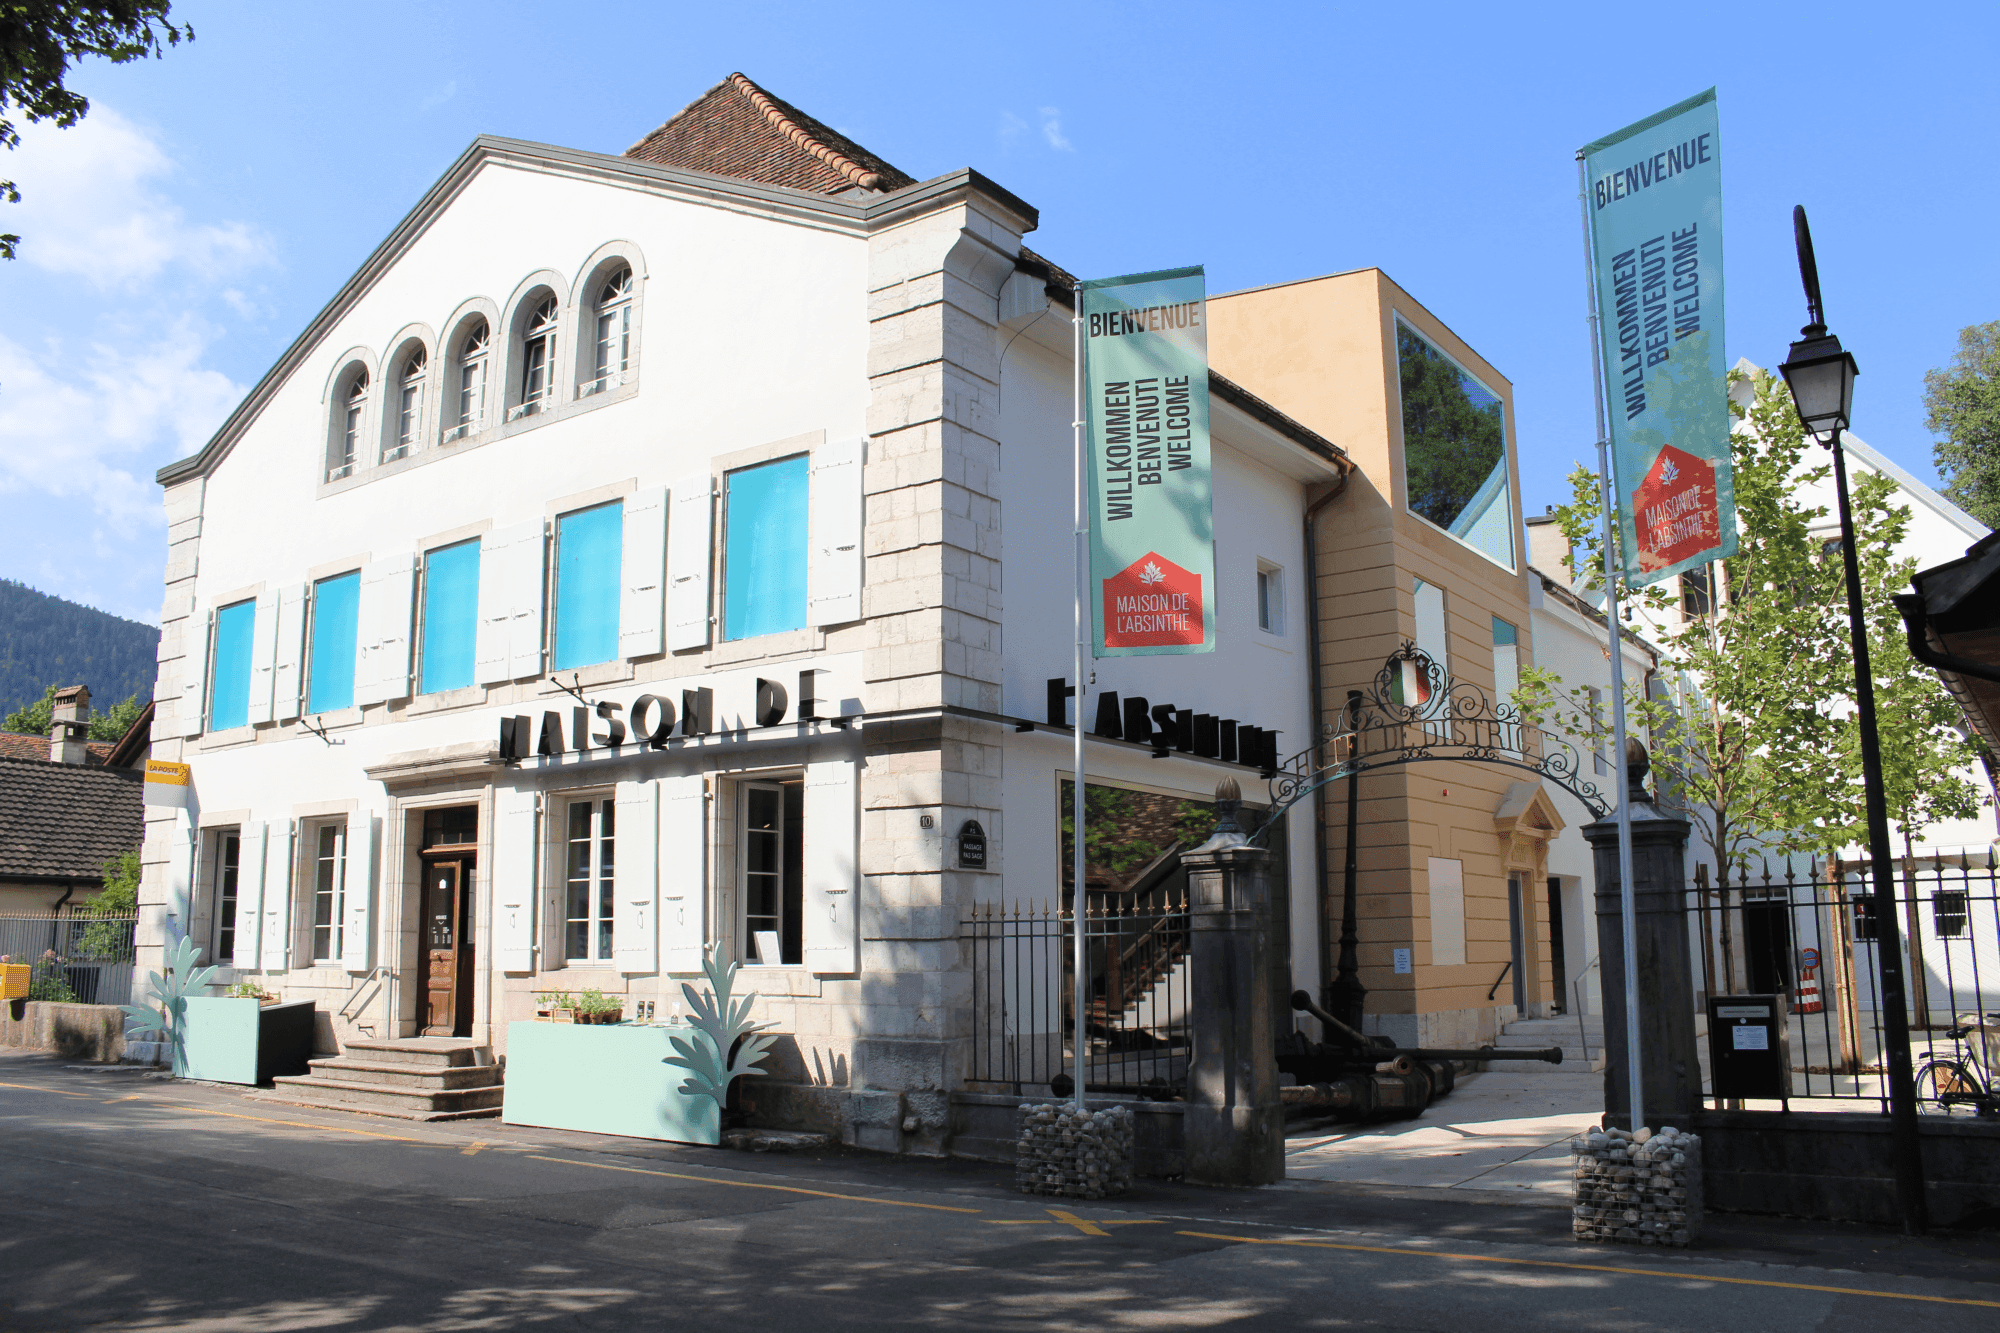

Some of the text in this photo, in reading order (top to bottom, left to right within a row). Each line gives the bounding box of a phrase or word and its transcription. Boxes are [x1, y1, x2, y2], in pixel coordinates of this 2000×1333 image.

[1595, 133, 1711, 210] BIENVENUE
[1090, 301, 1200, 338] BIENVENUE
[1640, 235, 1670, 367] BENVENUTI
[1672, 222, 1700, 343] WELCOME
[1612, 248, 1647, 421] WILLKOMMEN
[1105, 381, 1133, 522] WILLKOMMEN
[1135, 377, 1162, 486] BENVENUTI
[1165, 375, 1192, 472] WELCOME
[1645, 485, 1702, 529] MAISON DE
[1649, 511, 1705, 553] L'ABSINTHE
[1117, 593, 1190, 613] MAISON DE
[1117, 613, 1191, 633] L'ABSINTHE
[500, 669, 830, 760] MAISON DE
[1295, 719, 1548, 784] HTEL DE DISTRICT
[921, 816, 931, 827] 10
